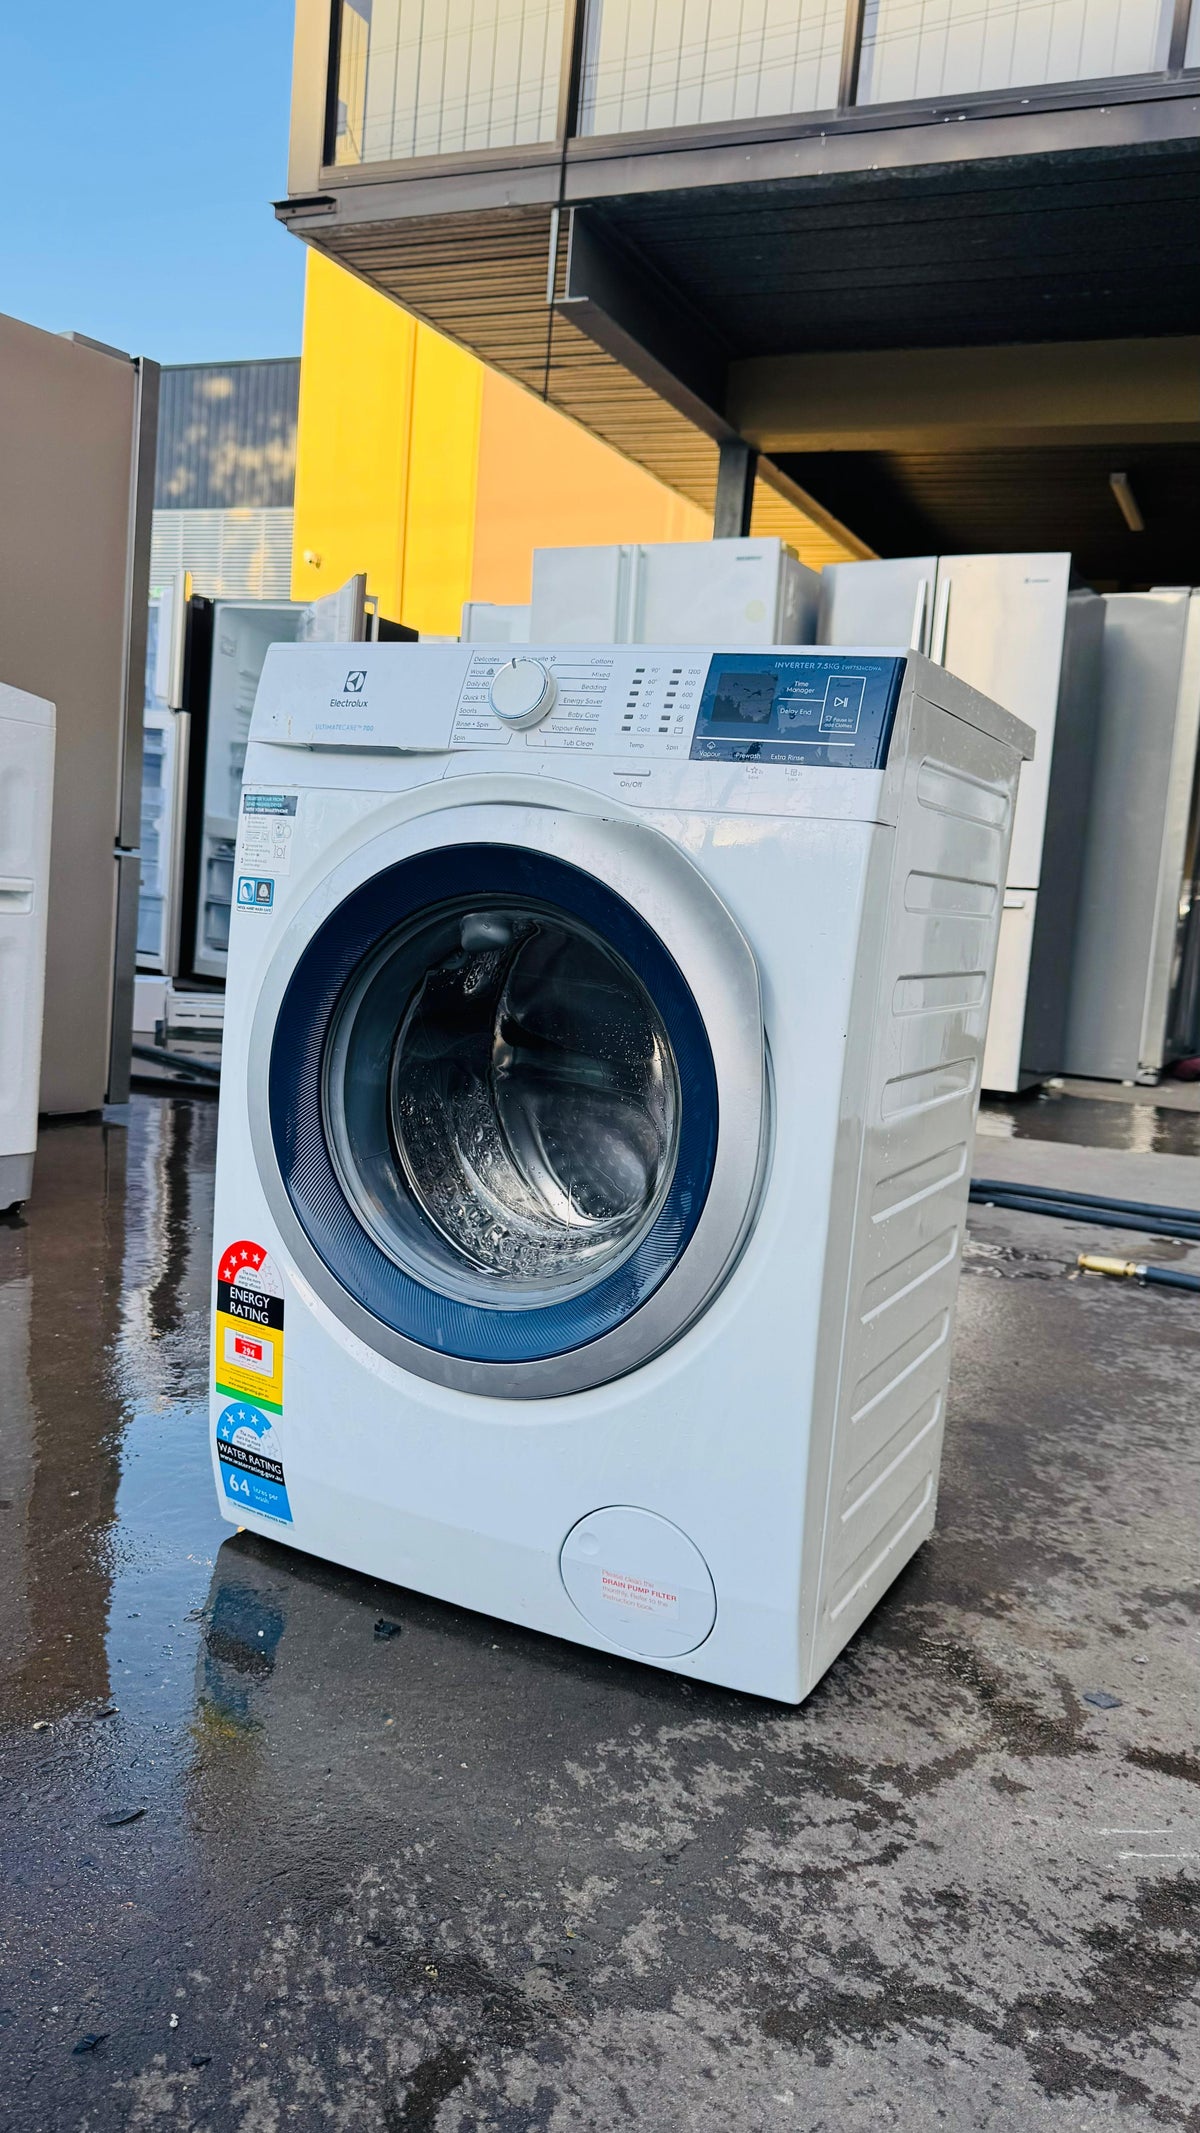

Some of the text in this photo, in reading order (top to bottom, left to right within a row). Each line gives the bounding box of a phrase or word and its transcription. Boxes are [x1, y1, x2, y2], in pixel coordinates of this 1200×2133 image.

[786, 687, 815, 695] Manager
[330, 699, 368, 707] Electrolux
[699, 750, 721, 758] Vapour
[230, 1286, 270, 1309] ENERGY
[230, 1301, 269, 1324] RATING
[242, 1346, 255, 1357] 294
[218, 1441, 282, 1475] WATER RATING
[229, 1473, 251, 1497] 64
[602, 1569, 654, 1588] Please clean the
[602, 1577, 677, 1602] DRAIN PUMP FILTER
[630, 1591, 647, 1602] Refer
[602, 1593, 635, 1607] instruction
